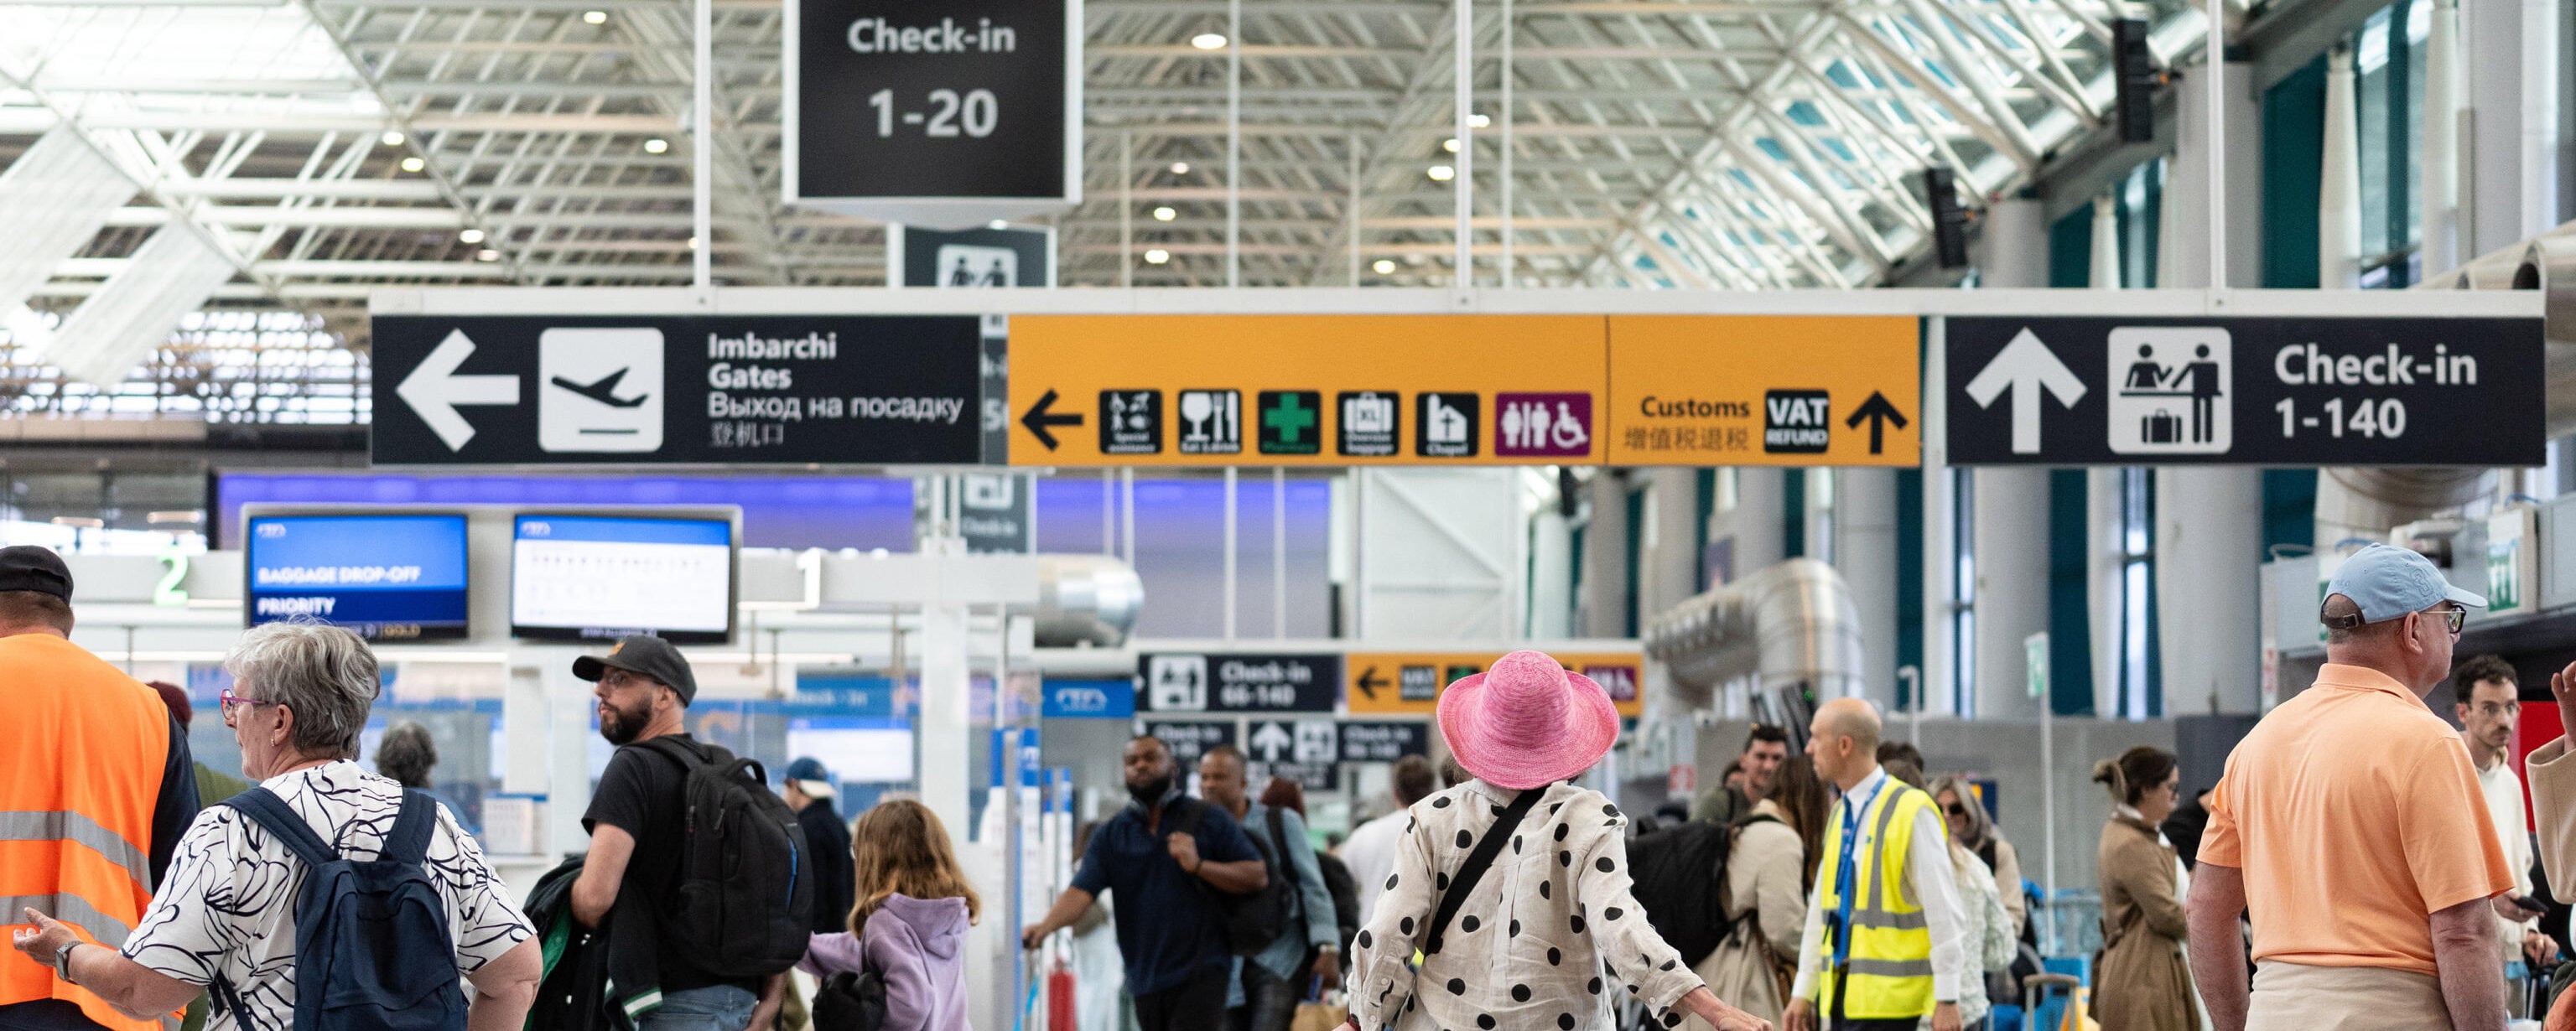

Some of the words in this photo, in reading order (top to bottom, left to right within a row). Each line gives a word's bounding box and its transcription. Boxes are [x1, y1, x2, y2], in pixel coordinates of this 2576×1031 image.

[847, 18, 1016, 54] Check-in
[869, 88, 999, 138] 1-20
[709, 331, 837, 359] Imbarchi
[709, 362, 792, 389] Gates
[2274, 343, 2477, 386] Check-in
[709, 391, 802, 422] Выход
[808, 397, 844, 417] на
[850, 396, 964, 425] посадку
[1641, 396, 1750, 417] Customs
[1767, 397, 1829, 426] VAT
[2275, 397, 2407, 438] 1-140
[712, 422, 784, 448] 登机口
[1766, 428, 1828, 446] REFUND
[153, 547, 190, 607] 2
[257, 566, 337, 585] BAGGAGE
[339, 565, 421, 584] DROP-OFF
[796, 547, 821, 610] 1
[257, 596, 336, 616] PRIORITY
[1220, 661, 1312, 684] Check-in
